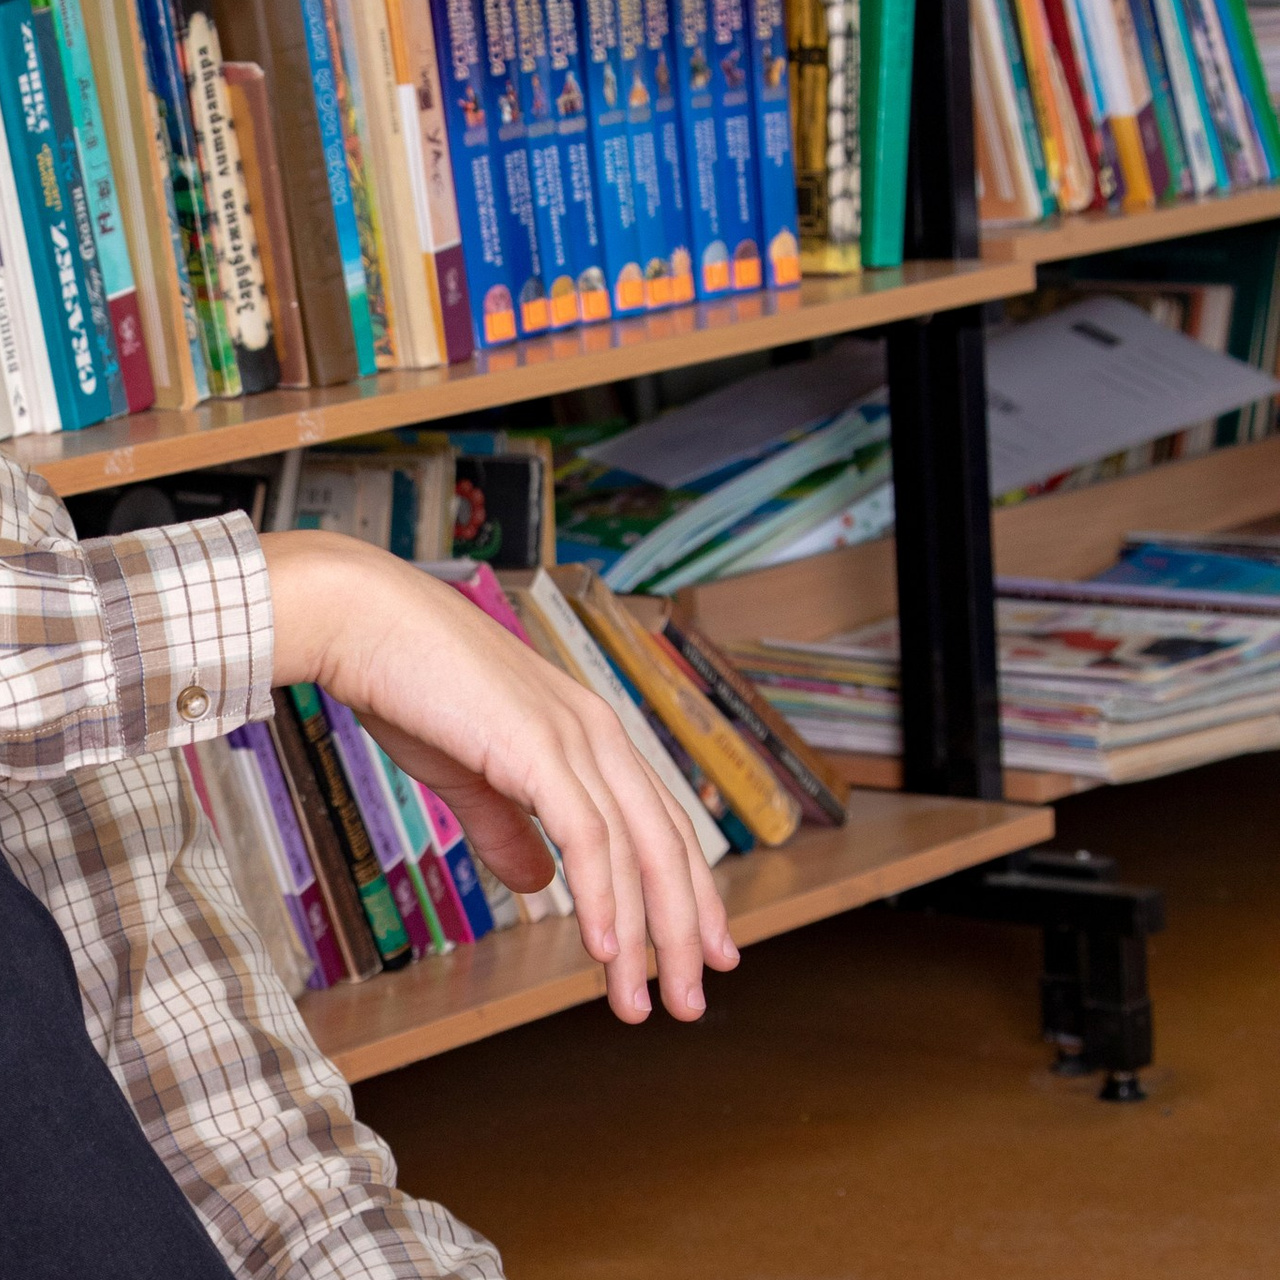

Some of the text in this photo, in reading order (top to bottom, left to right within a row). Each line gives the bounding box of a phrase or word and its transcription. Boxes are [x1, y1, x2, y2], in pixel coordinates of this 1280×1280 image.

[70, 185, 96, 261] Сказки
[196, 43, 258, 314] Зарубежная литература
[50, 219, 98, 394] СКАЗКИ
